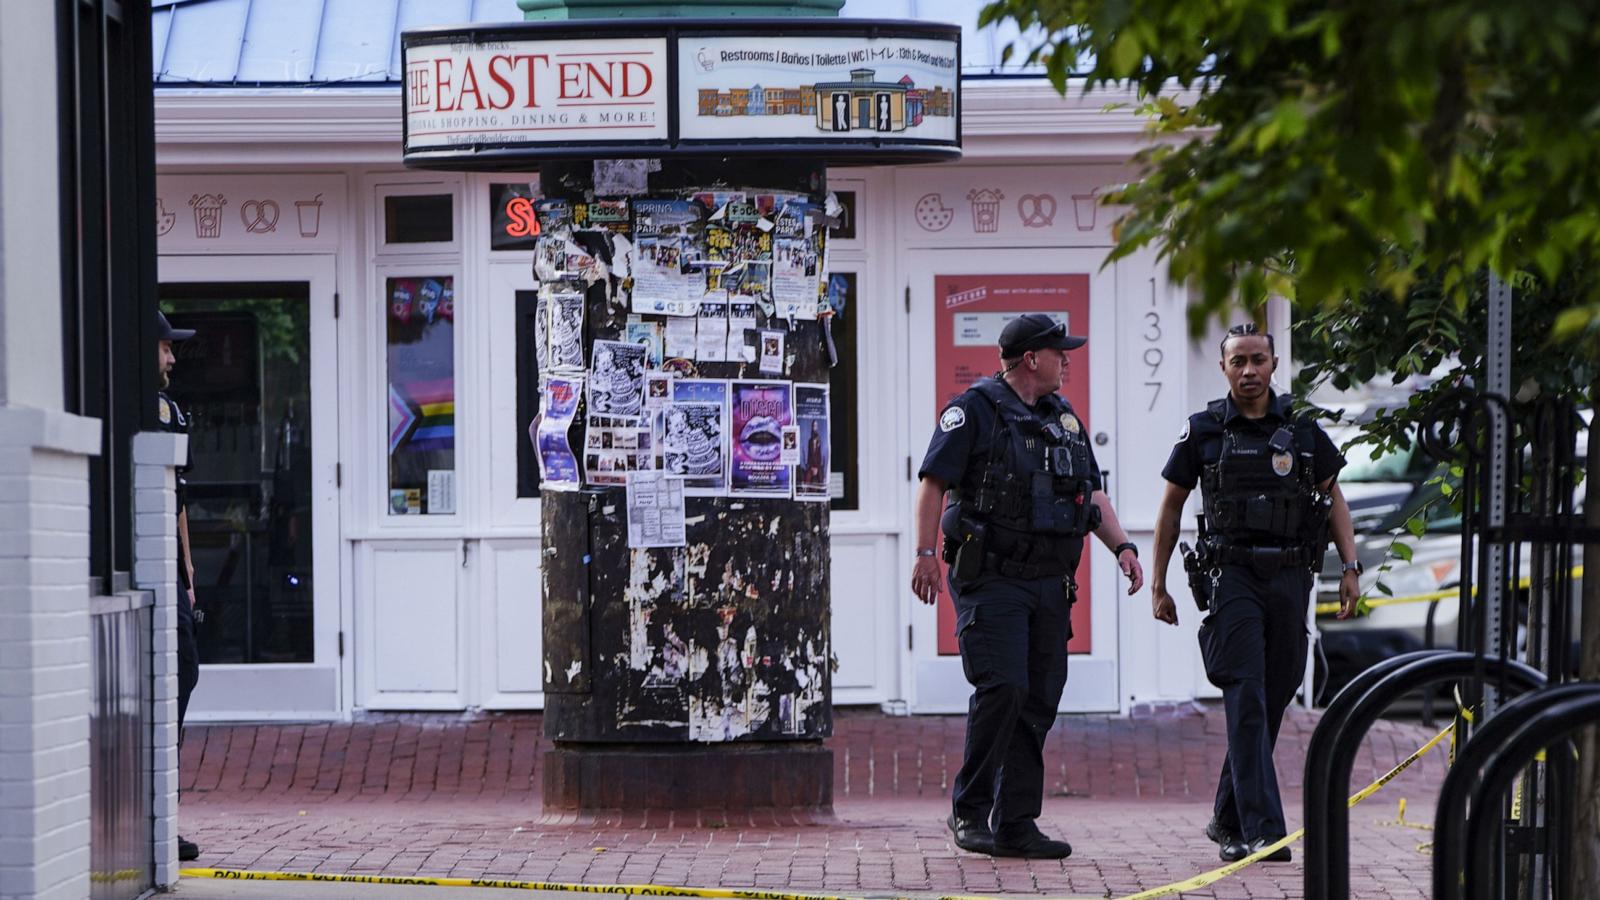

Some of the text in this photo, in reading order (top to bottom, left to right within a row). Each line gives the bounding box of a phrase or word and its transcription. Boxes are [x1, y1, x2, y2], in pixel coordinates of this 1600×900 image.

[721, 50, 774, 62] Restrooms
[781, 52, 810, 66] Baños
[817, 53, 847, 66] Toilette
[852, 50, 865, 63] WC
[900, 47, 911, 59] 13th
[434, 55, 549, 112] EAST
[557, 61, 653, 99] END
[512, 113, 569, 125] DINING
[579, 112, 588, 123] &
[599, 111, 656, 123] MORE!
